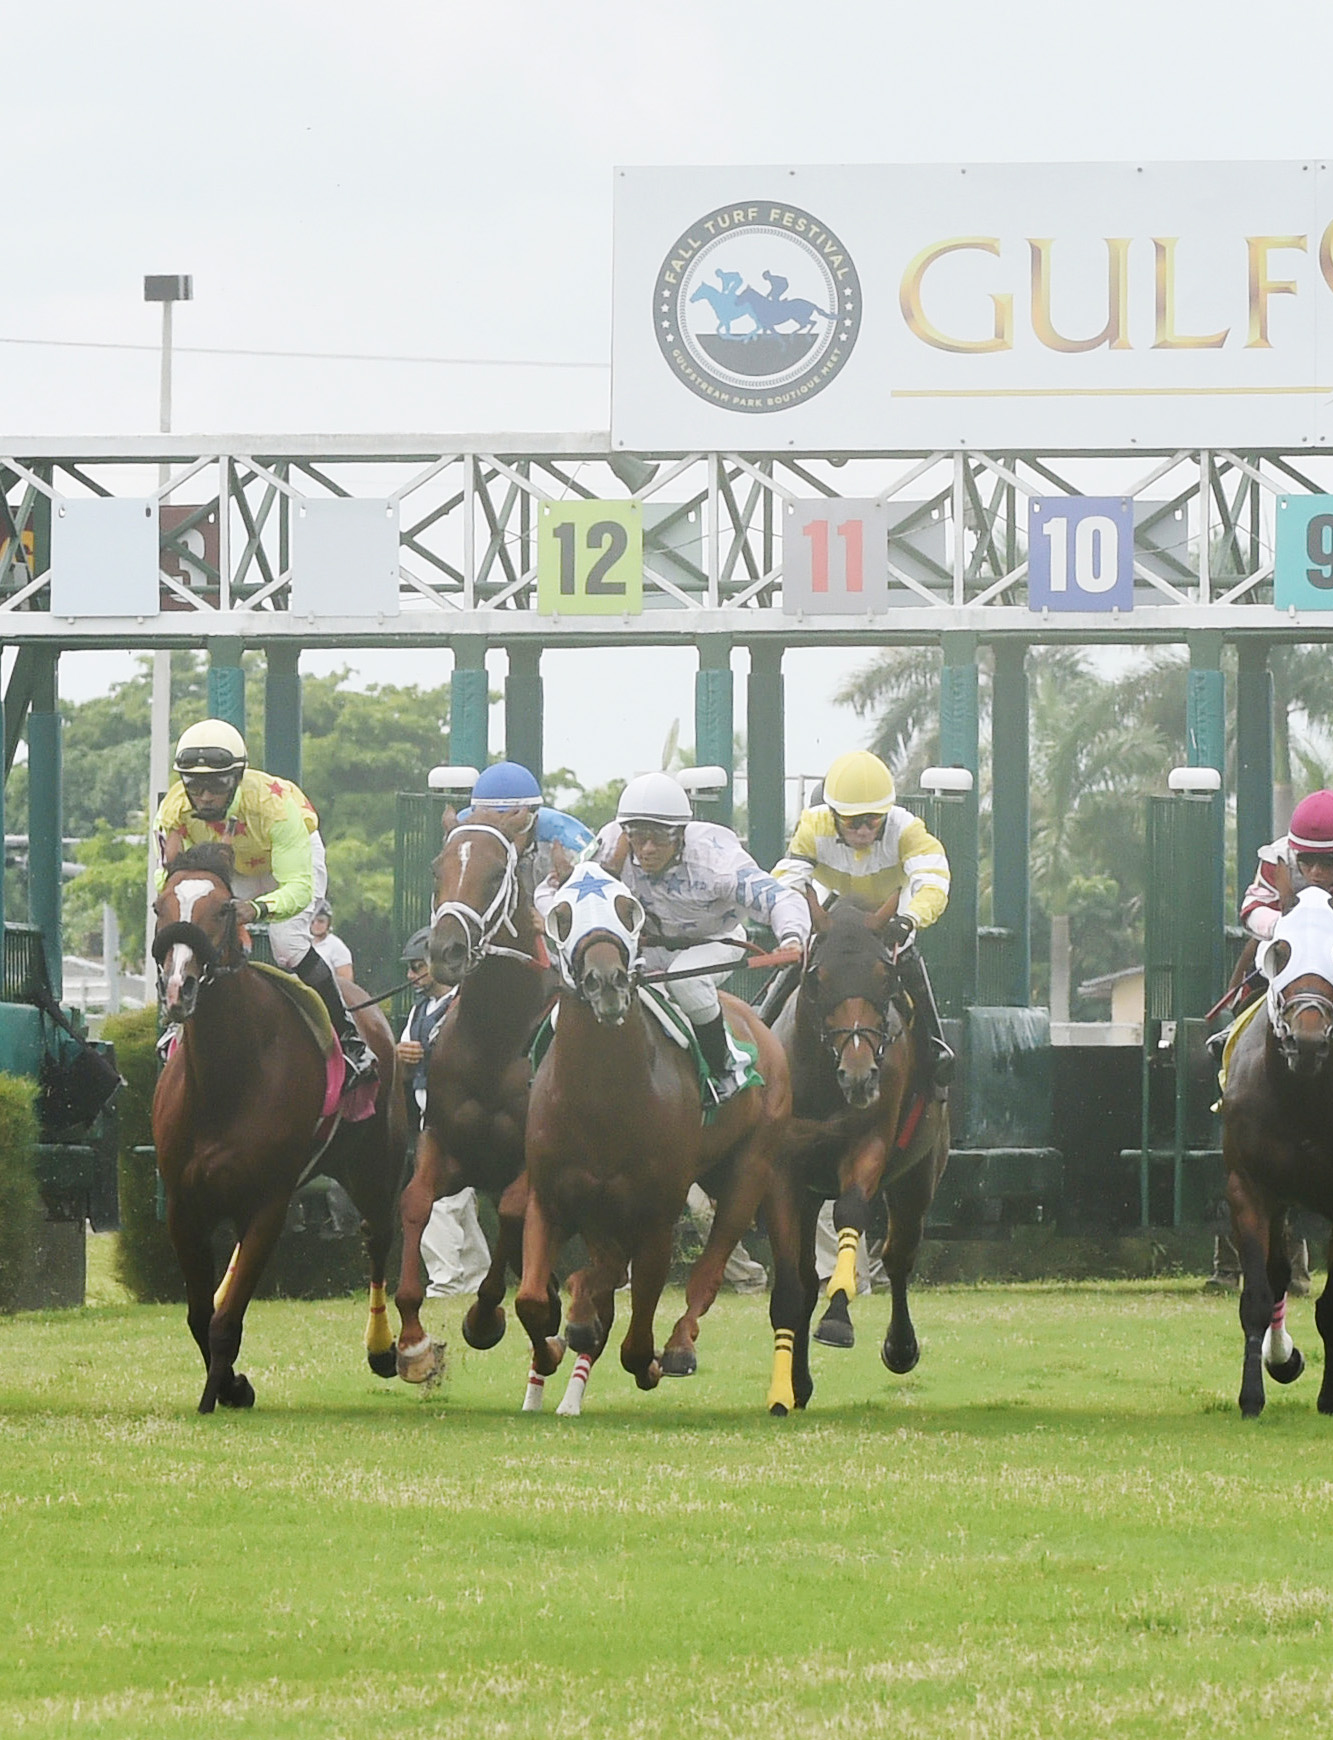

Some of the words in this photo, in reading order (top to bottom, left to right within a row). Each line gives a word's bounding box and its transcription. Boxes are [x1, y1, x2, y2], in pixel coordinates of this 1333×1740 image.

[664, 238, 701, 284] FALL
[704, 207, 759, 234] TURF
[769, 208, 849, 280] FESTIVAL
[671, 348, 730, 402] GULFSTREAM
[732, 395, 764, 408] PARK
[767, 373, 823, 407] BOUTIQUE
[820, 347, 843, 377] MEET
[552, 521, 628, 596] 12
[802, 519, 864, 593] 11
[1041, 514, 1119, 593] 10
